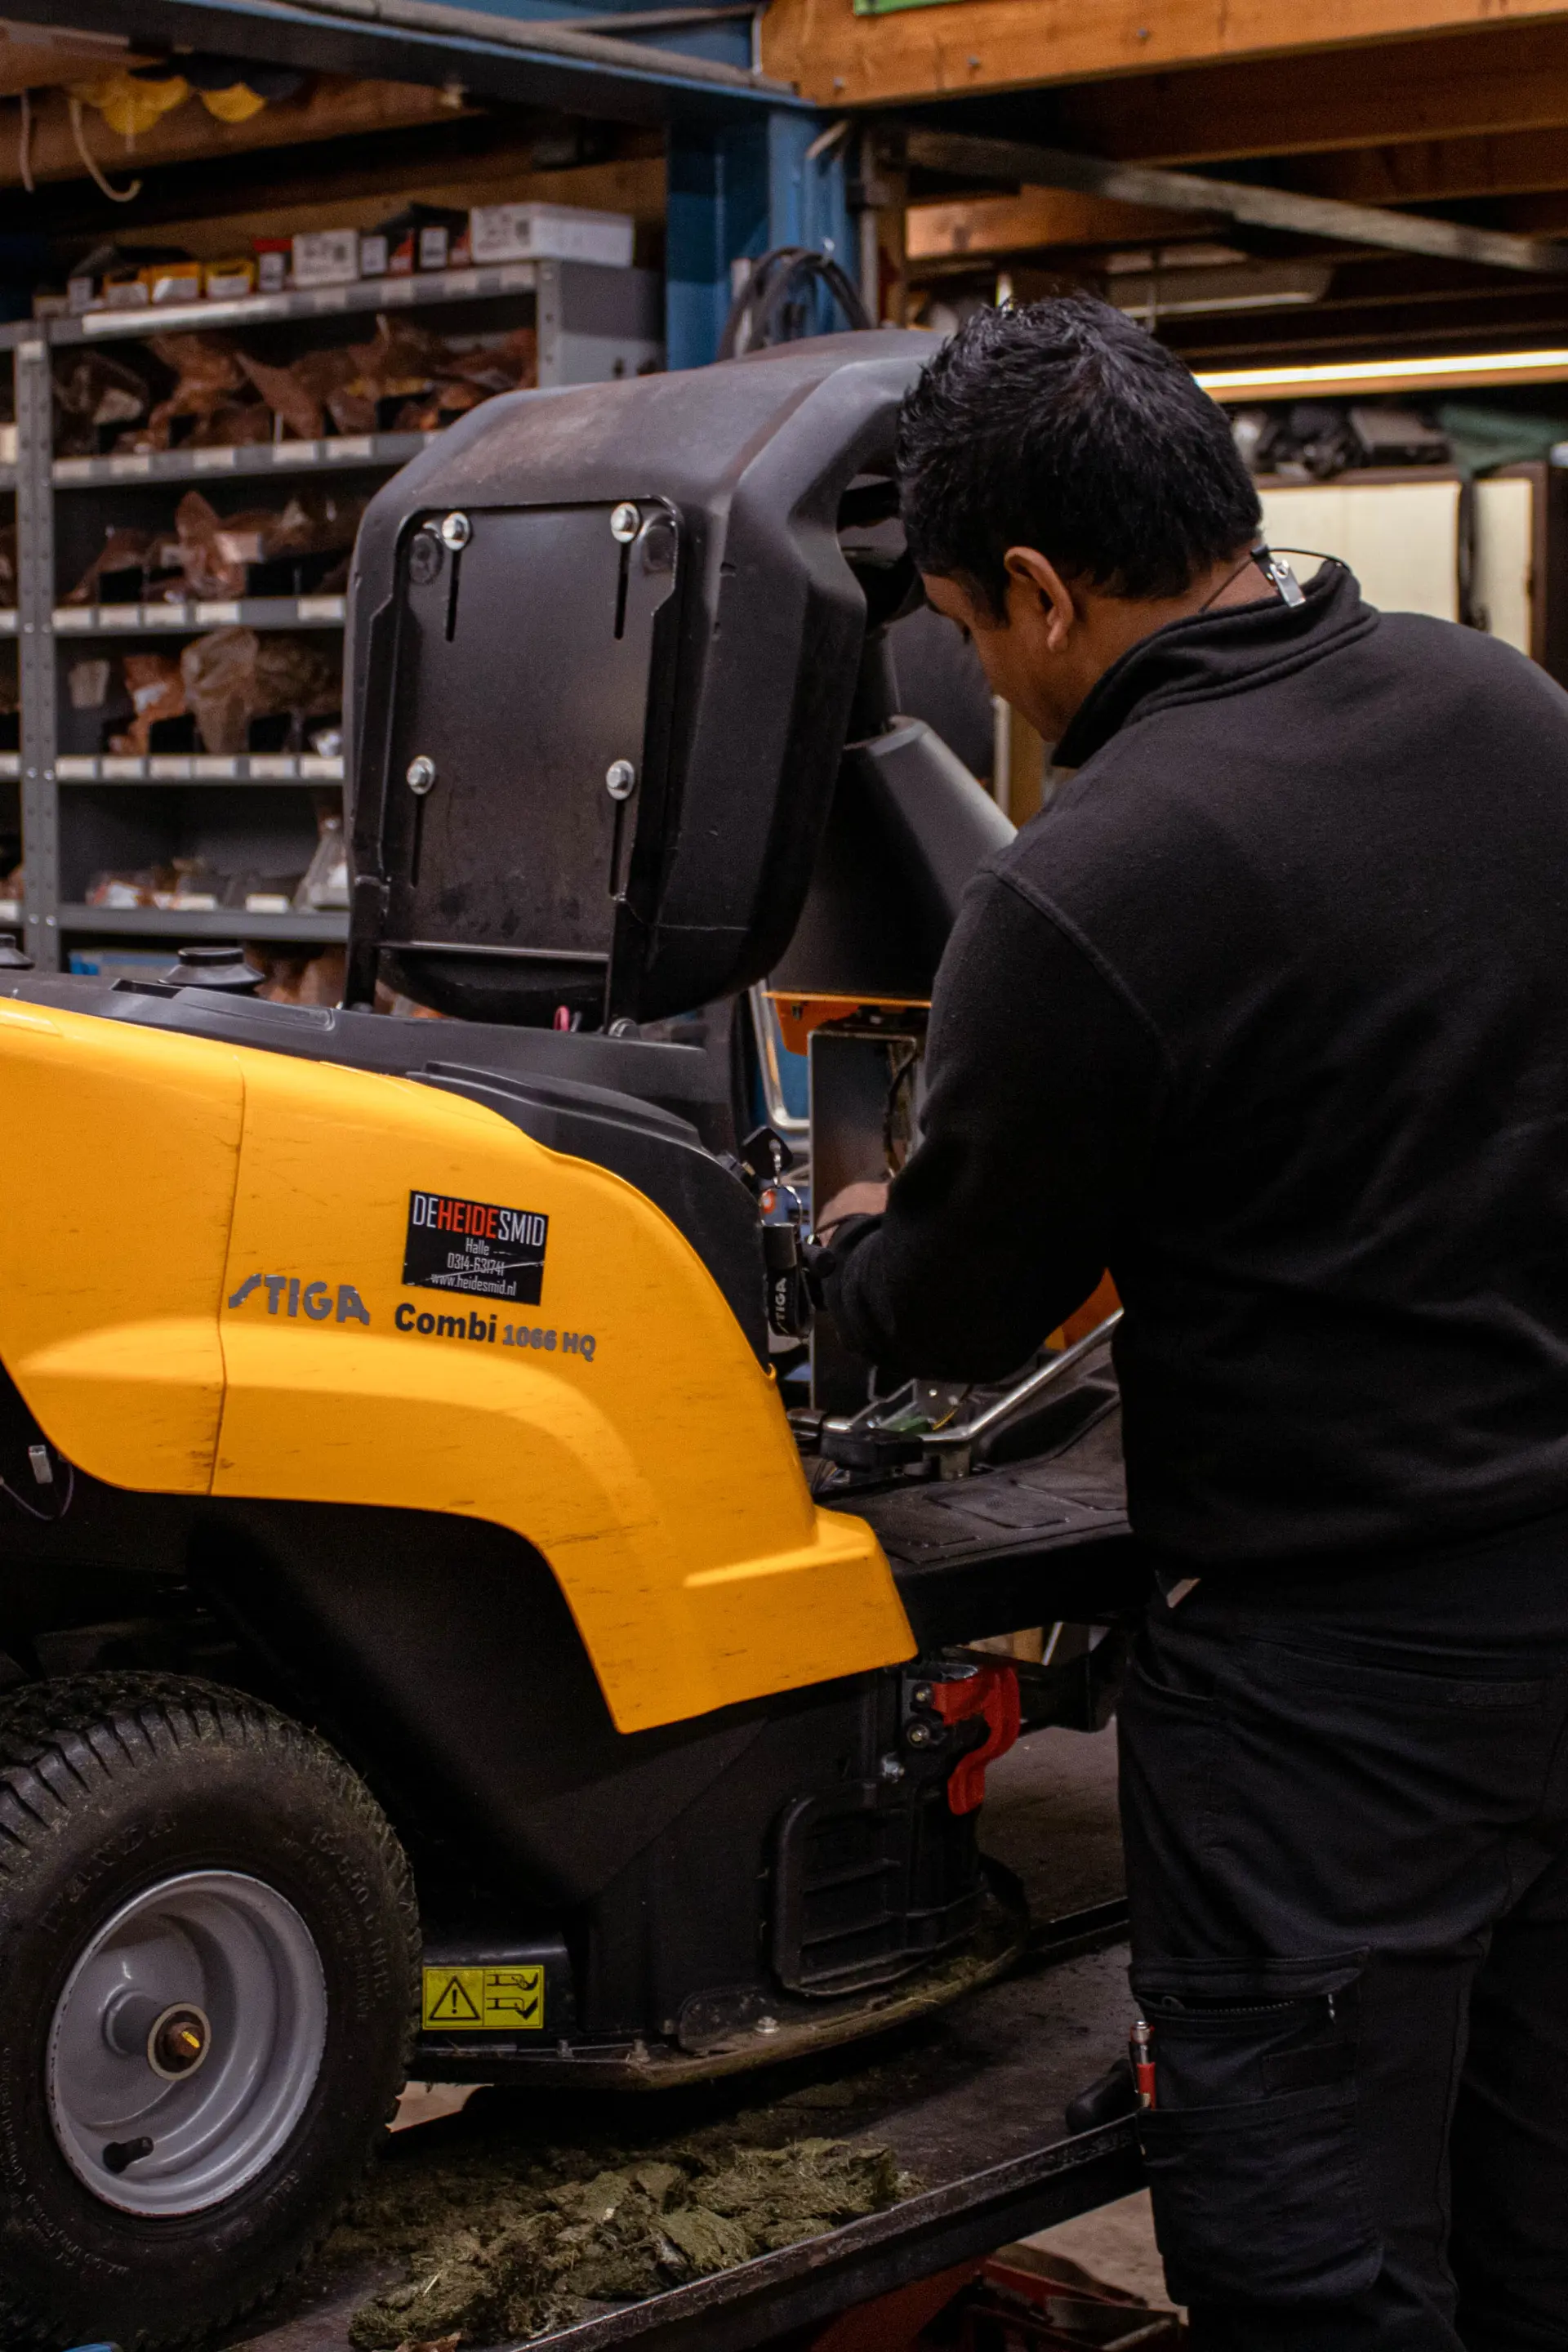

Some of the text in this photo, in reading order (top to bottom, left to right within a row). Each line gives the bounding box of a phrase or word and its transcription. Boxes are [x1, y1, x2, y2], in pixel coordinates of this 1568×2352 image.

[412, 1194, 546, 1247] DEHEIDESMID
[466, 1238, 490, 1256] Halle
[228, 1273, 371, 1325] STIGA
[431, 1273, 517, 1297] www.heidesmid.nl
[394, 1303, 596, 1362] Combi 1066 HQ
